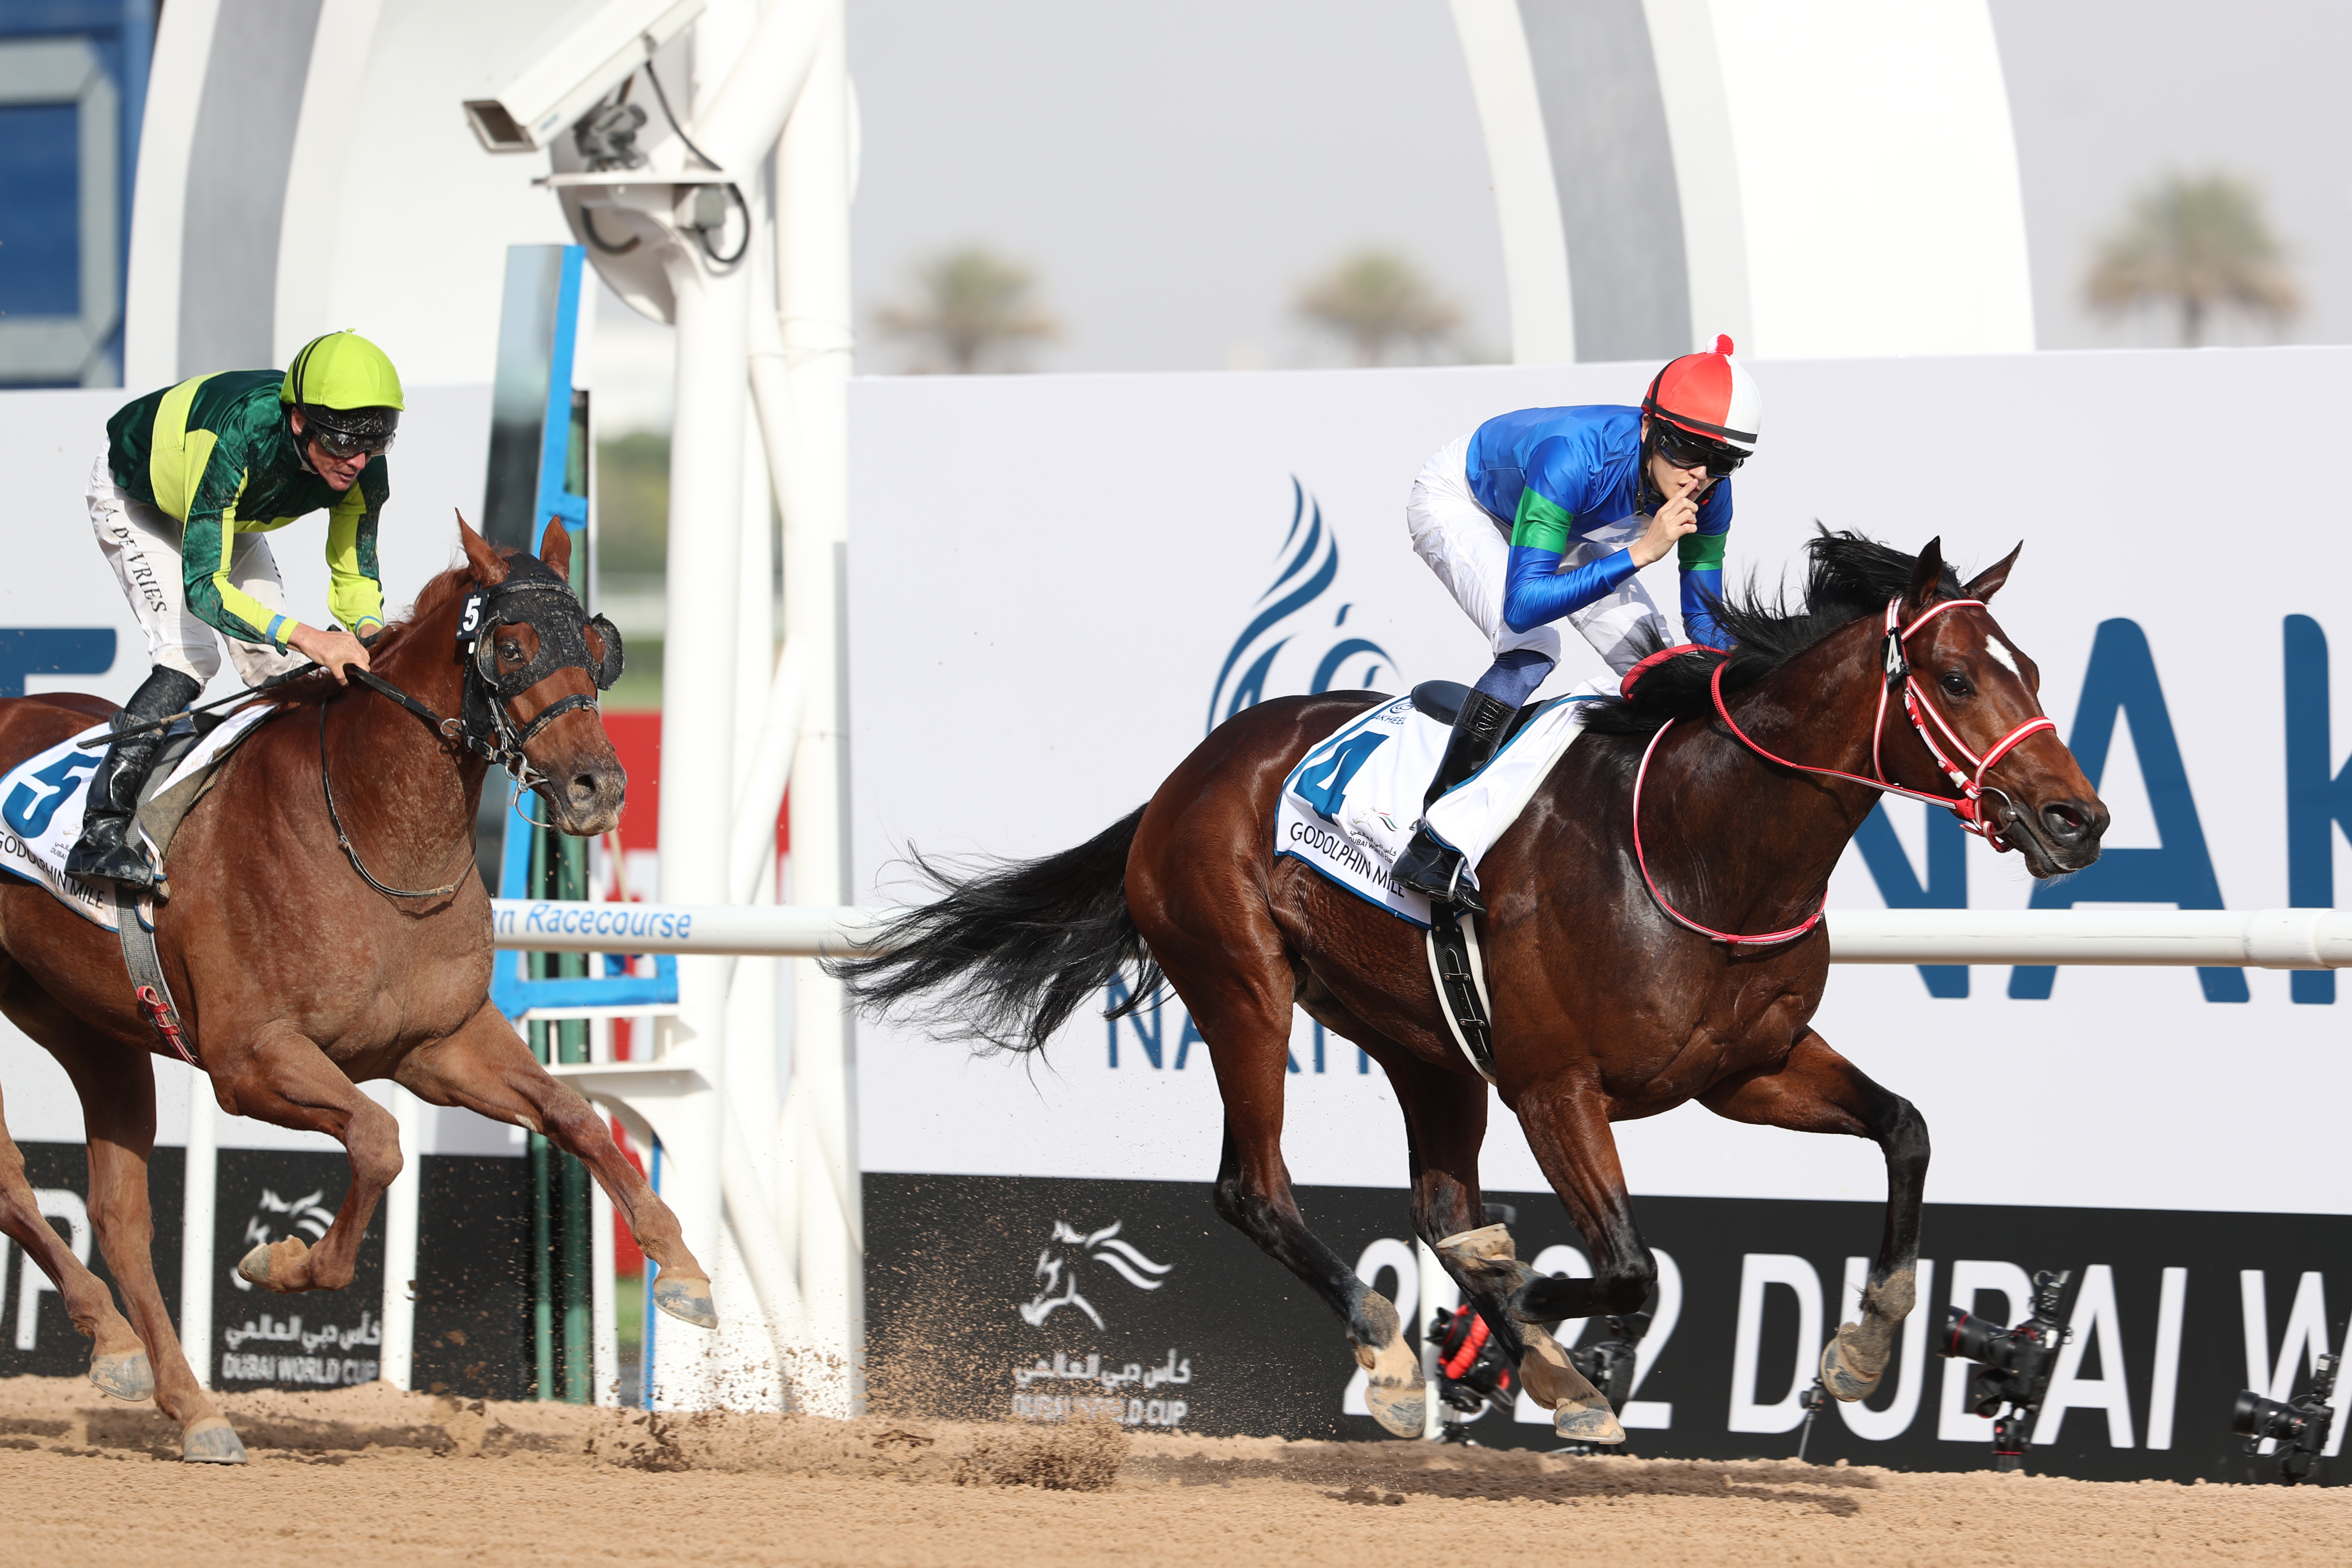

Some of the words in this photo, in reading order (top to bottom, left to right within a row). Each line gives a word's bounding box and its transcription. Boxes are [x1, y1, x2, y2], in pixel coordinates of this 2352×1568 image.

[110, 527, 138, 550] DE
[126, 552, 168, 612] VRIES
[462, 597, 481, 631] 5
[1886, 634, 1902, 674] 4
[1371, 714, 1406, 725] AKHEEL
[2, 751, 103, 838] 5
[1293, 730, 1390, 827] 4
[50, 847, 67, 860] DUBAI
[1290, 822, 1371, 879] GODOLPHIN
[1372, 865, 1405, 898] MILE
[1349, 837, 1368, 847] DUBAI
[1369, 842, 1384, 858] WORLD
[1384, 855, 1393, 864] CUP
[70, 878, 104, 909] MILE
[527, 903, 691, 938] Racecourse
[1343, 1238, 1682, 1431] 222
[1727, 1253, 2187, 1451] DUBAI
[222, 1351, 276, 1381] DUBAI
[277, 1354, 341, 1384] WORLD
[1145, 1398, 1188, 1426] CUP
